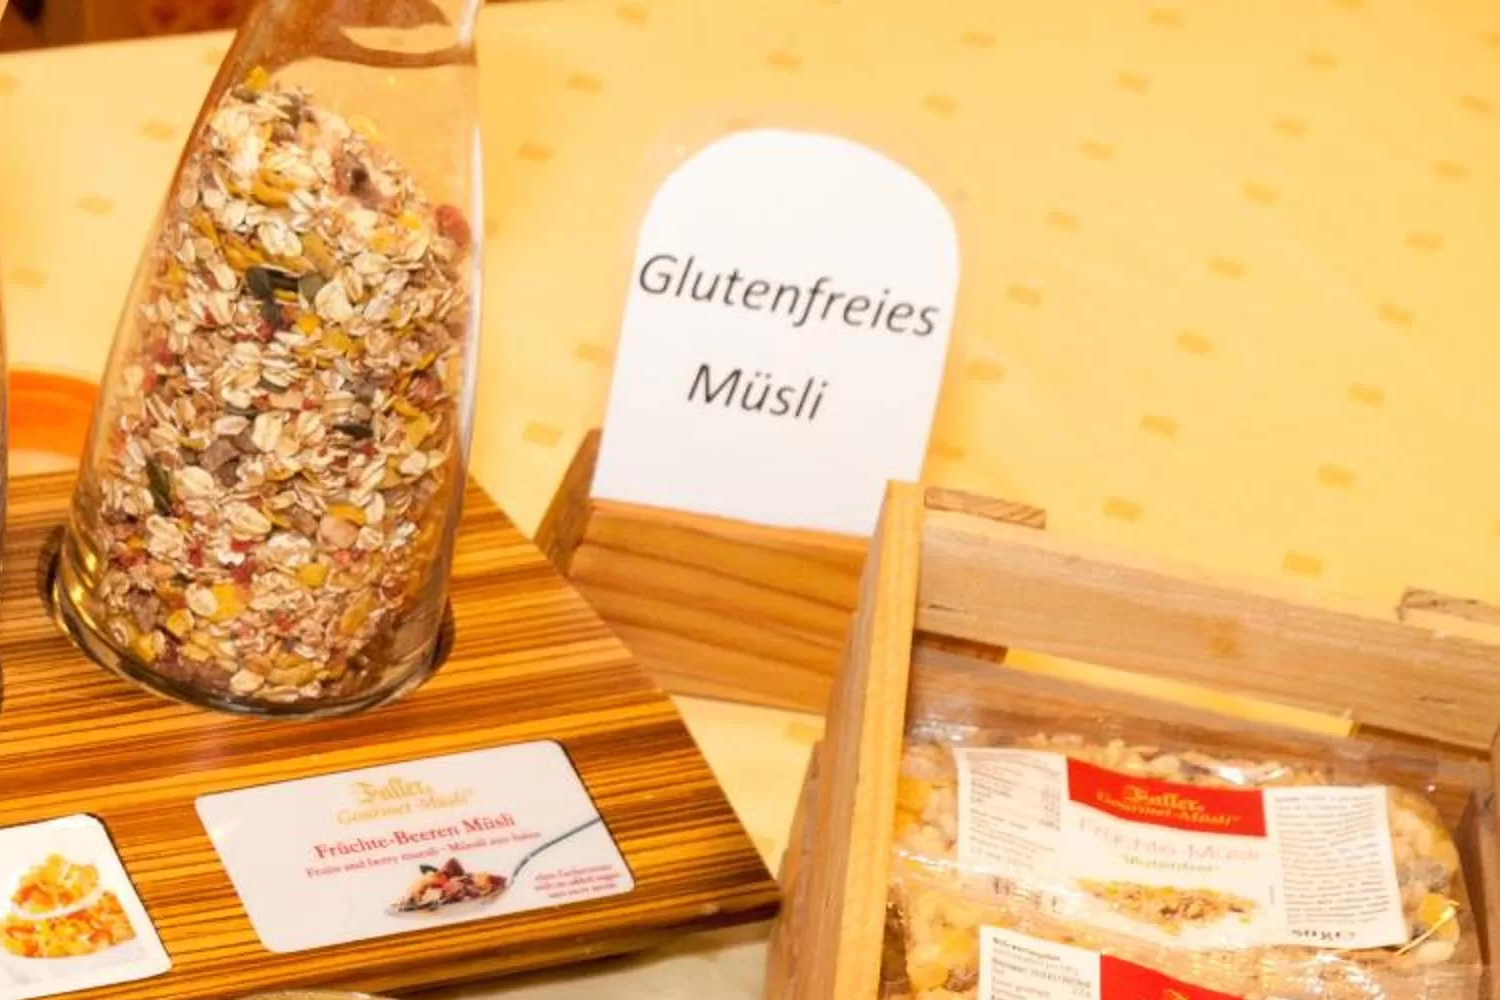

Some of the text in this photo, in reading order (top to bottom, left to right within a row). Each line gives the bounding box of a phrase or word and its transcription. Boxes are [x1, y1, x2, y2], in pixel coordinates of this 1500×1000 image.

[639, 253, 941, 338] Glutenfreies
[687, 362, 829, 421] Müsli
[313, 813, 516, 859] Früchte-Beeren Müsli
